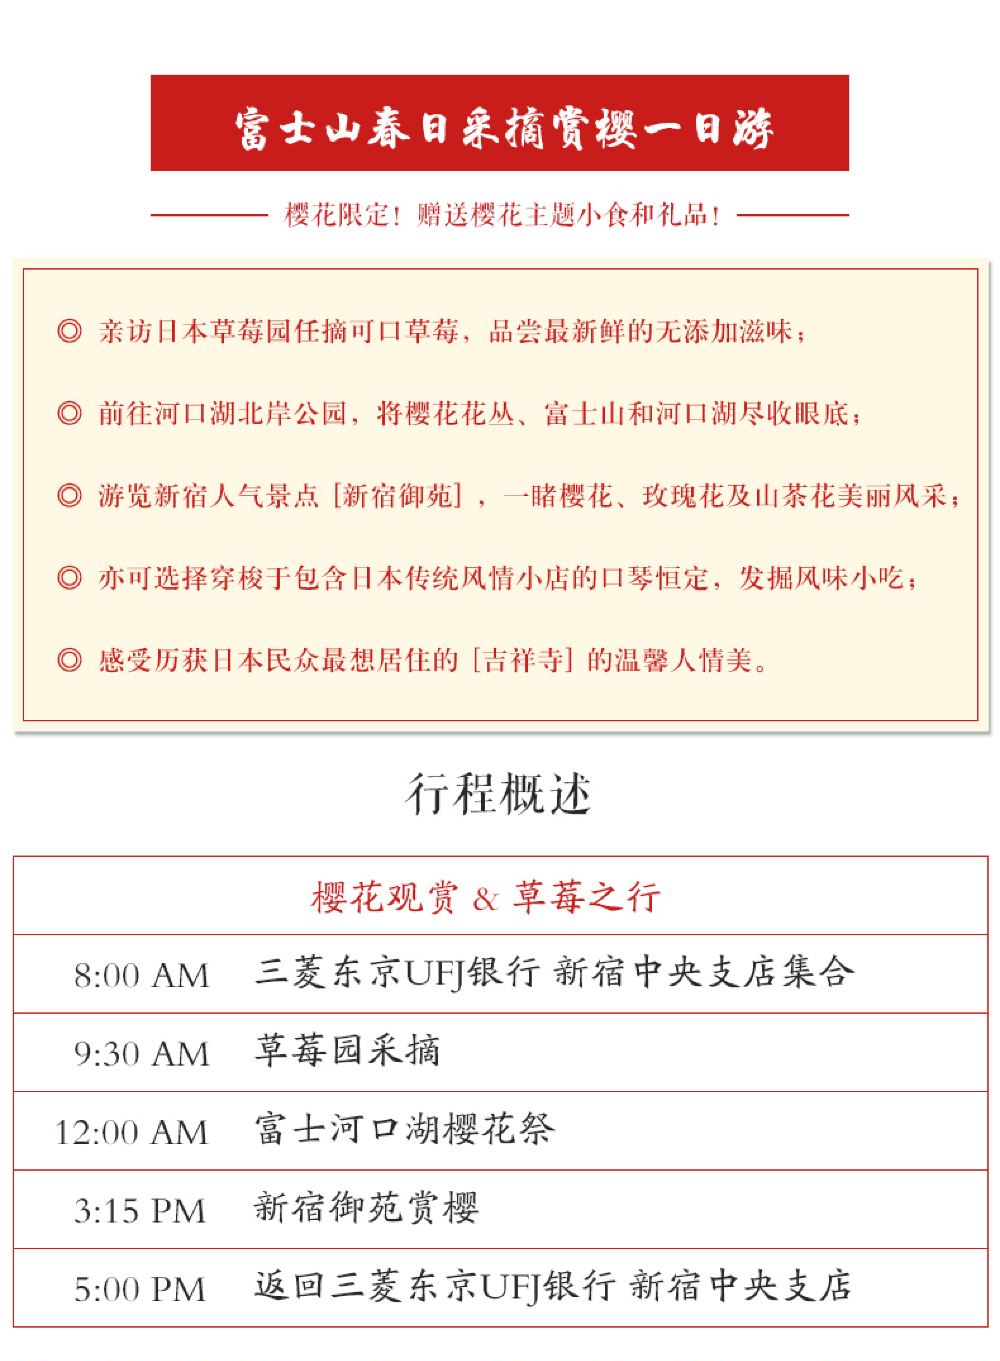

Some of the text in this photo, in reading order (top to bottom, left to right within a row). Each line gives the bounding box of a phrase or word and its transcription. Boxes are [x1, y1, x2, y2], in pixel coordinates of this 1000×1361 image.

[405, 772, 591, 816] 行程概述
[310, 878, 661, 915] 樱花观赏 & 草莓之行
[75, 963, 210, 988] 8:00 AM
[75, 1041, 210, 1066] 9:30 AM
[254, 1031, 439, 1068] 草莓园采摘
[57, 1120, 209, 1144] 12:00 AM
[75, 1198, 206, 1224] 3:15 PM
[253, 1190, 479, 1225] 新宿御苑赏樱
[75, 1277, 206, 1301] 5:00 PM
[629, 1268, 851, 1303] 新宿中央支店
